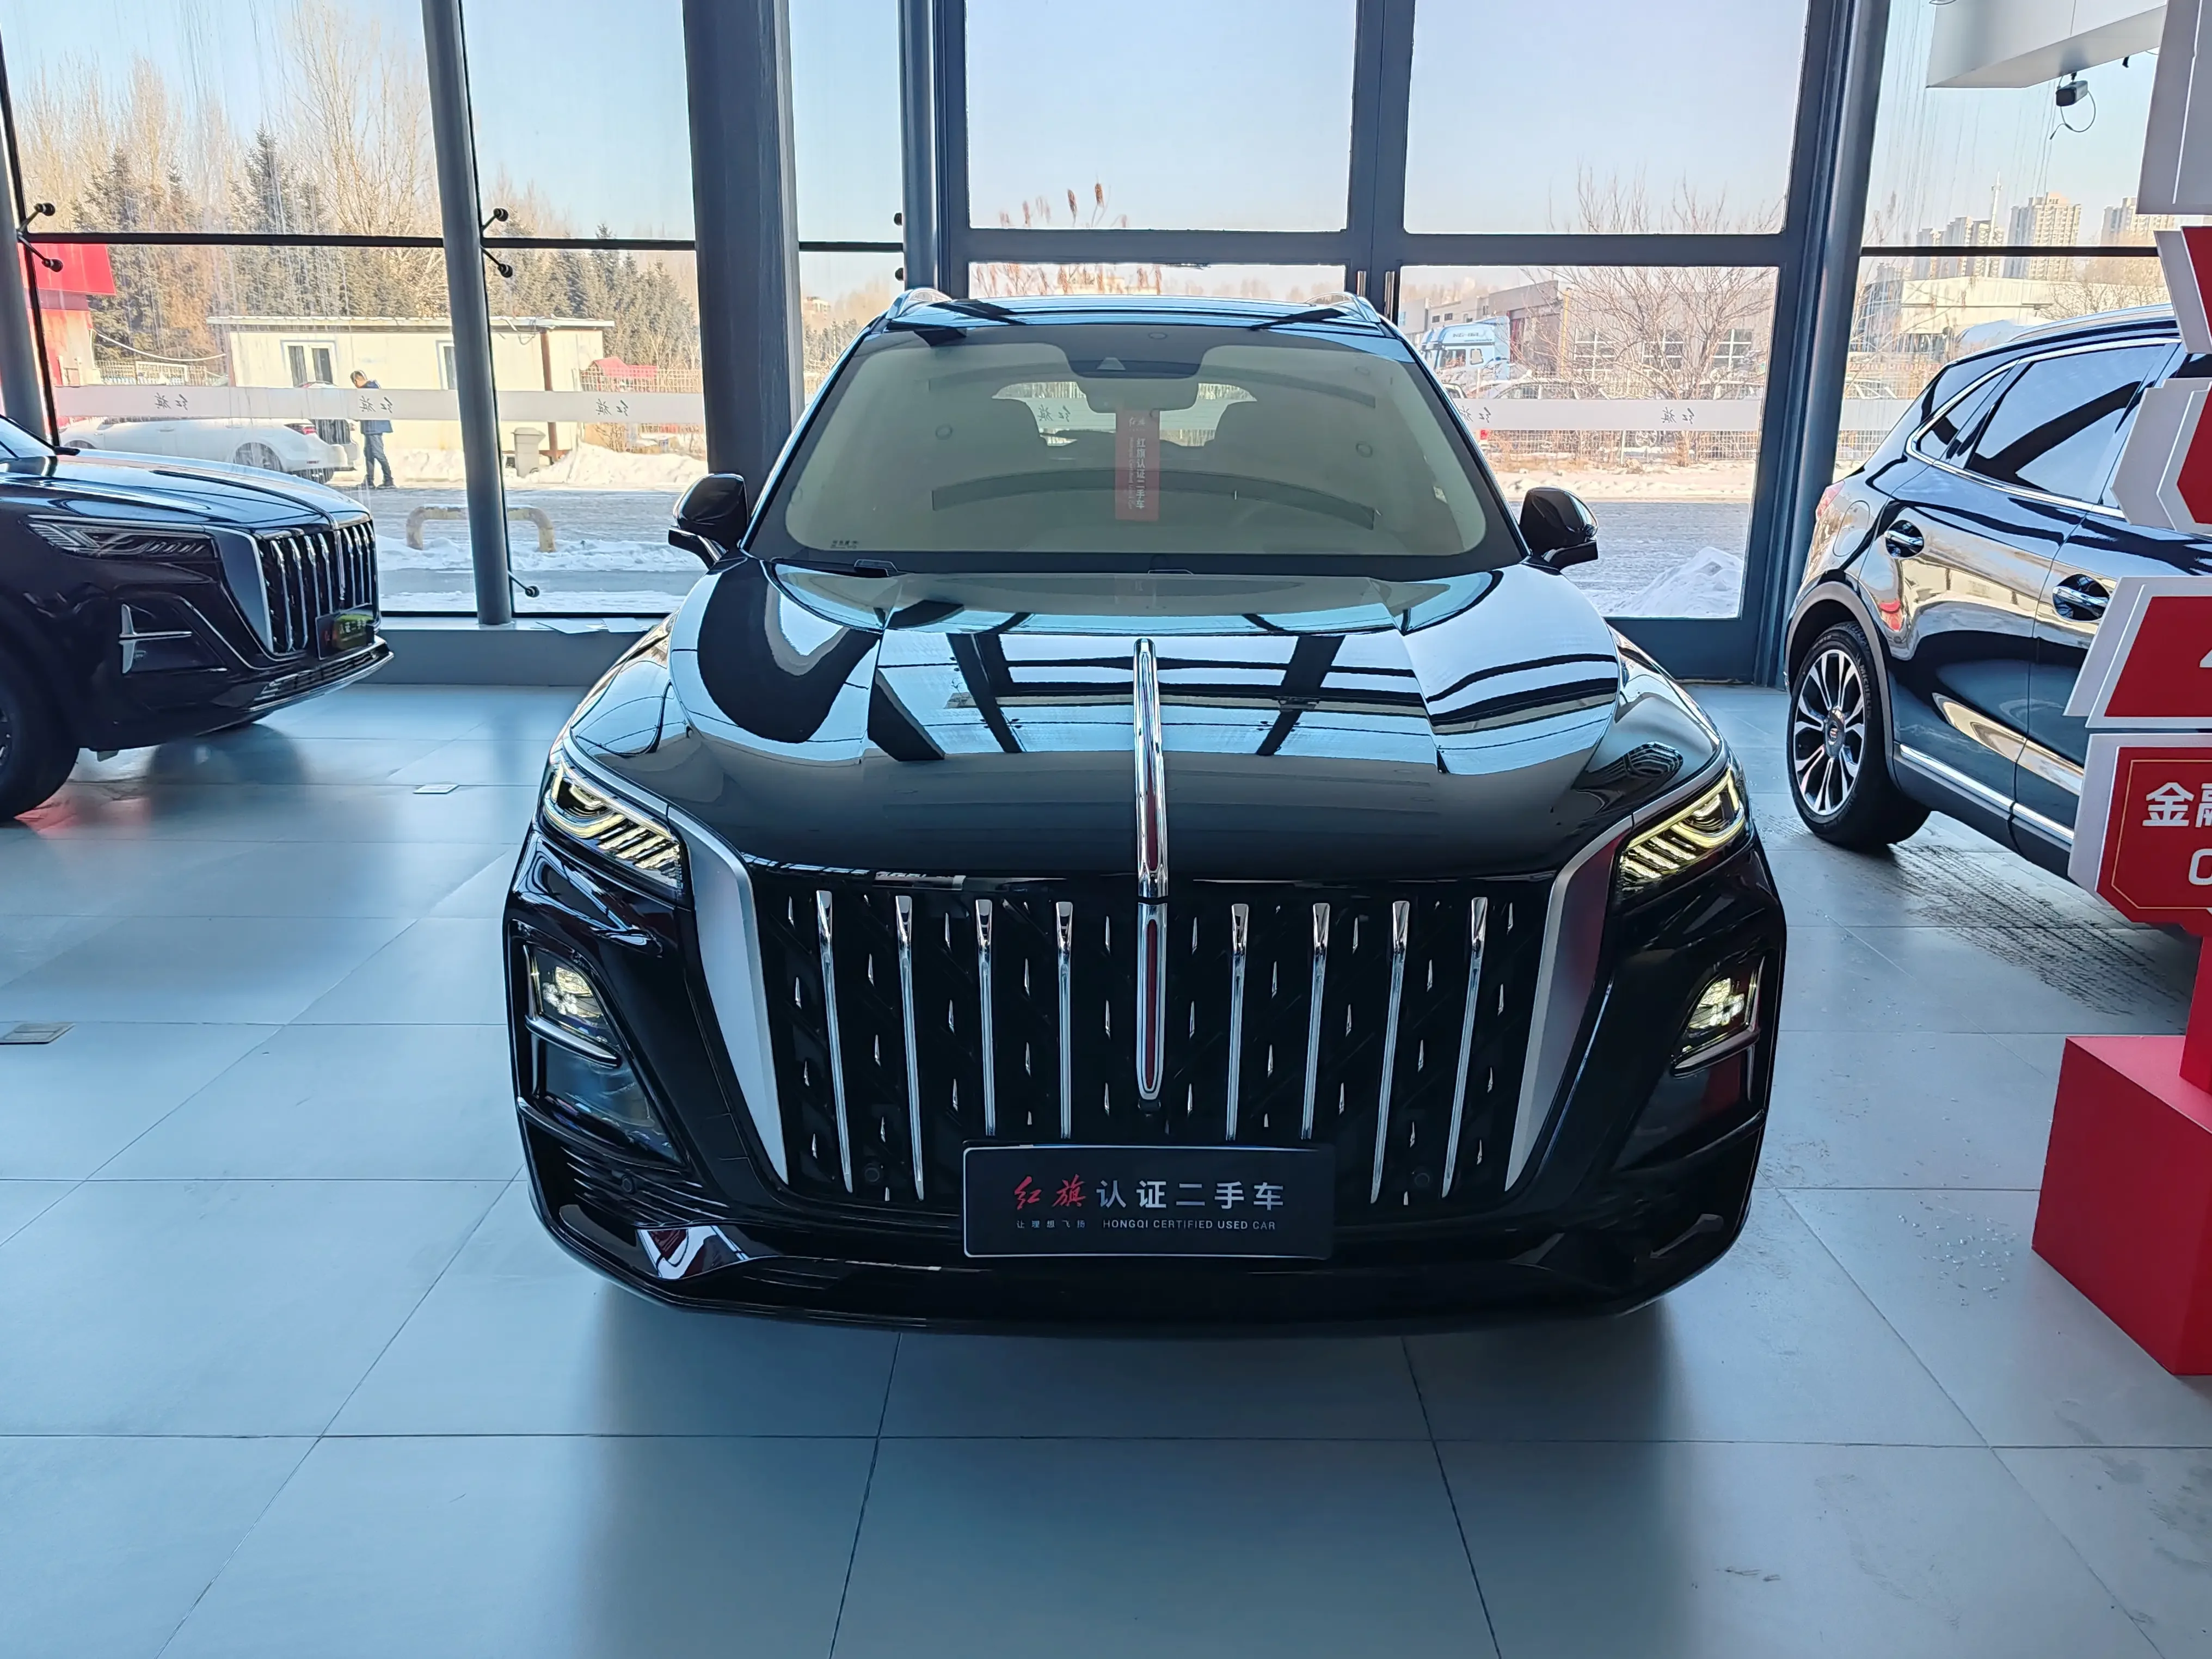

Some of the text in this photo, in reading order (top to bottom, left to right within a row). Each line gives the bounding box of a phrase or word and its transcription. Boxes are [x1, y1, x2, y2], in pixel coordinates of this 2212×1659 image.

[1103, 1220, 1275, 1230] HONGQI CERTIFIED USED CAR
